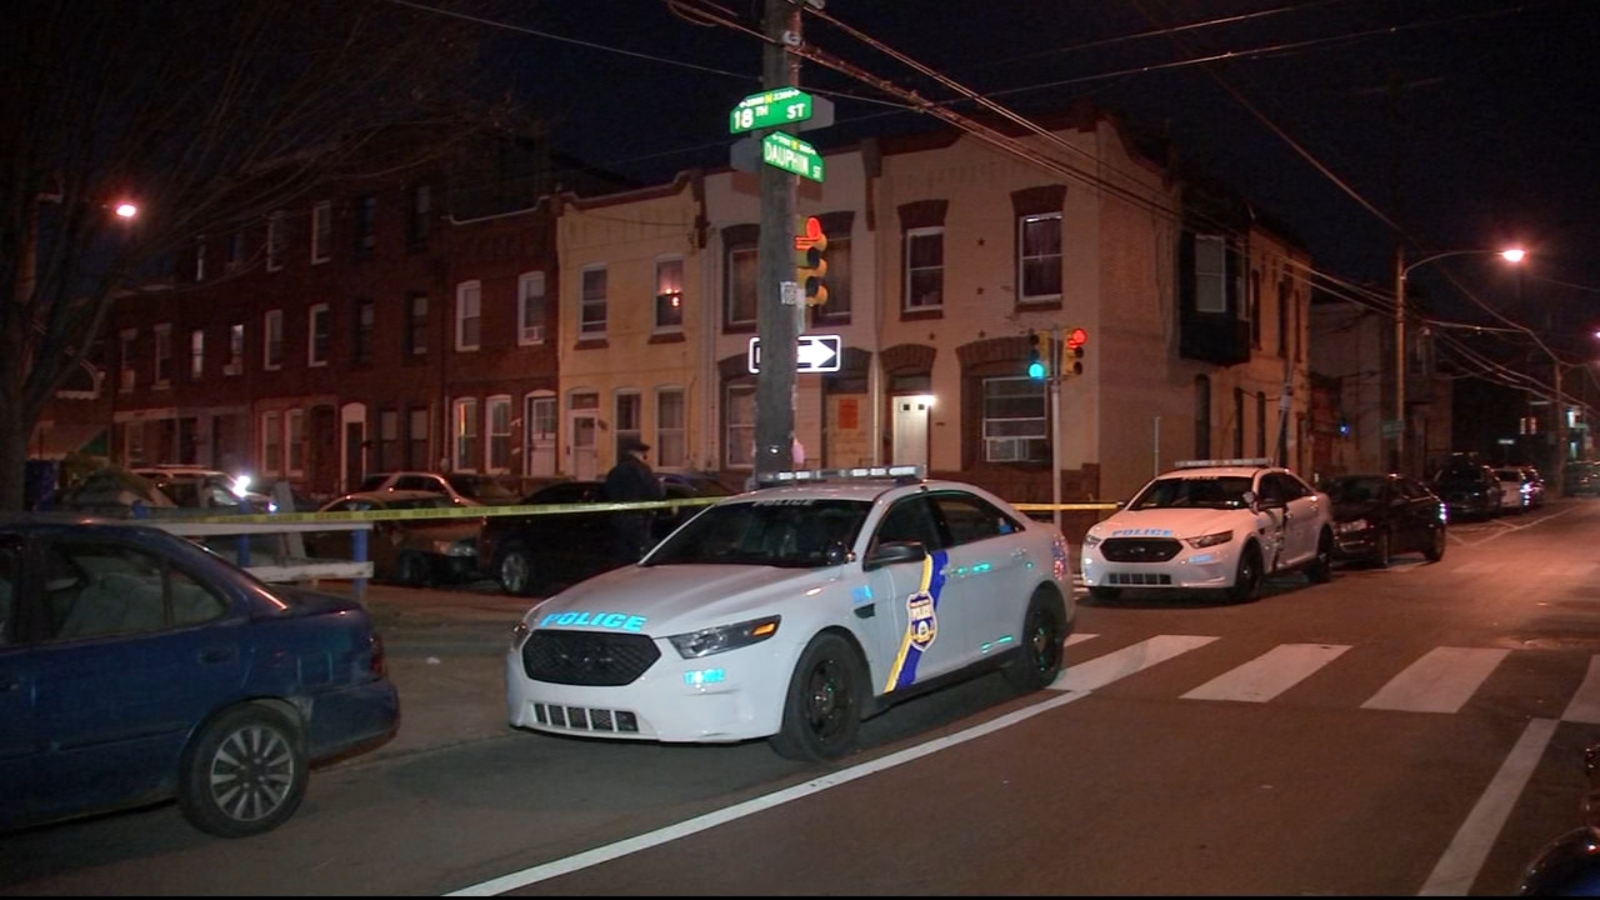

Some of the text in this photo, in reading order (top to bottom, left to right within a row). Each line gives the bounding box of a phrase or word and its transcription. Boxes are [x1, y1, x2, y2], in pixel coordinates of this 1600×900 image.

[735, 103, 805, 129] 18 TH ST
[764, 141, 809, 175] DAUPHIN
[1112, 529, 1173, 537] POLICE
[540, 611, 648, 632] POLICE
